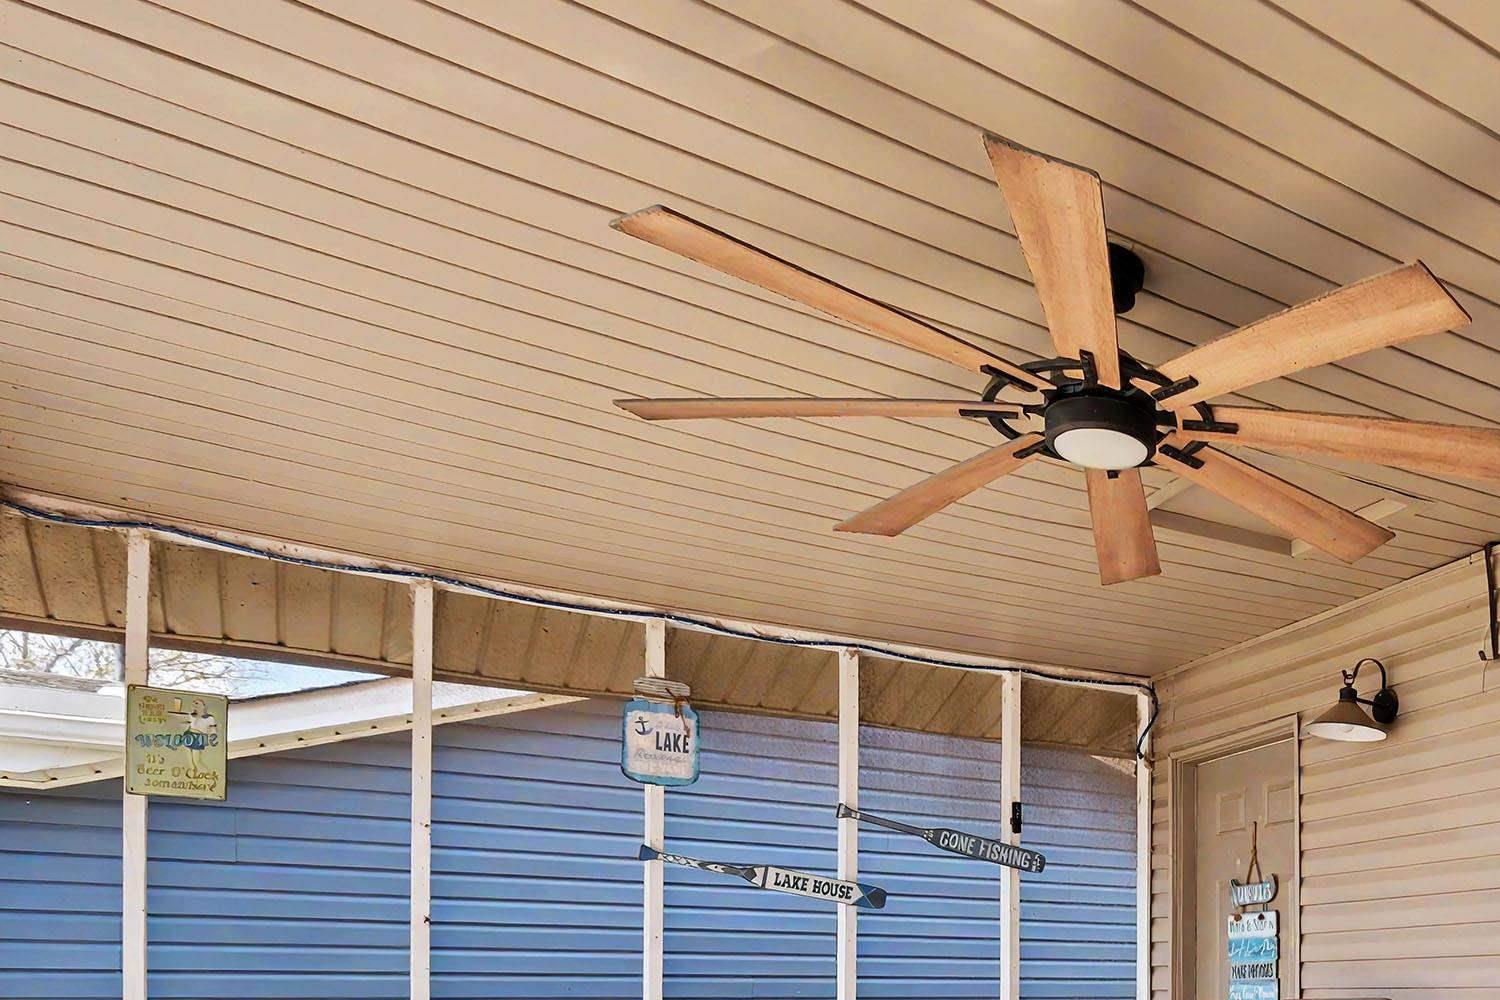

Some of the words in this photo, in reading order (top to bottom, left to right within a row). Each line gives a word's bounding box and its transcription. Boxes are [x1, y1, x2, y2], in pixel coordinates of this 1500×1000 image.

[656, 731, 689, 753] LAKE
[939, 831, 976, 855] GONE
[978, 839, 1032, 868] FISHING
[773, 872, 809, 892] LAKE
[812, 879, 854, 900] HOUSE
